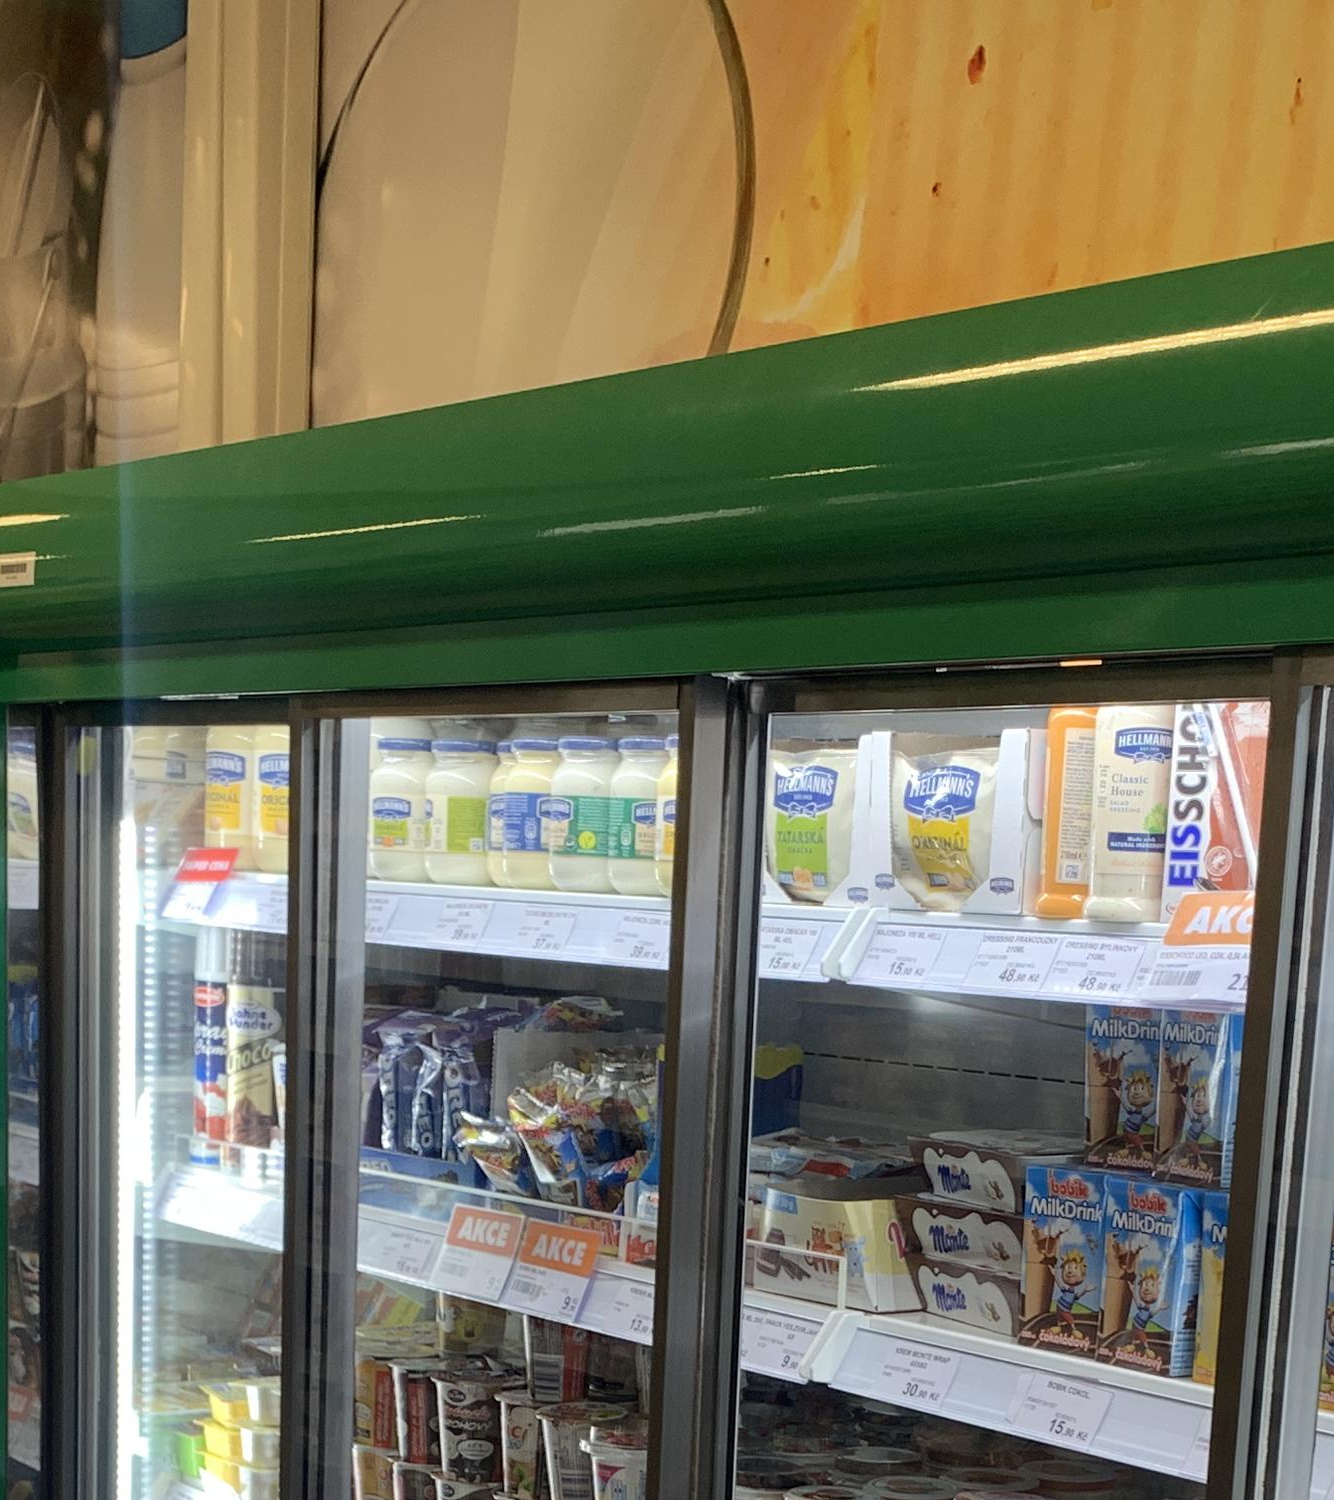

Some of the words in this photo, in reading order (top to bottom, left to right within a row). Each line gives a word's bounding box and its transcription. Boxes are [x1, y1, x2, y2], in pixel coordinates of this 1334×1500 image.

[1112, 773, 1148, 785] Classic
[1112, 786, 1143, 797] House
[1031, 1195, 1103, 1224] MilkDrink
[458, 1215, 509, 1249] AKCE
[532, 1234, 588, 1267] AKCE
